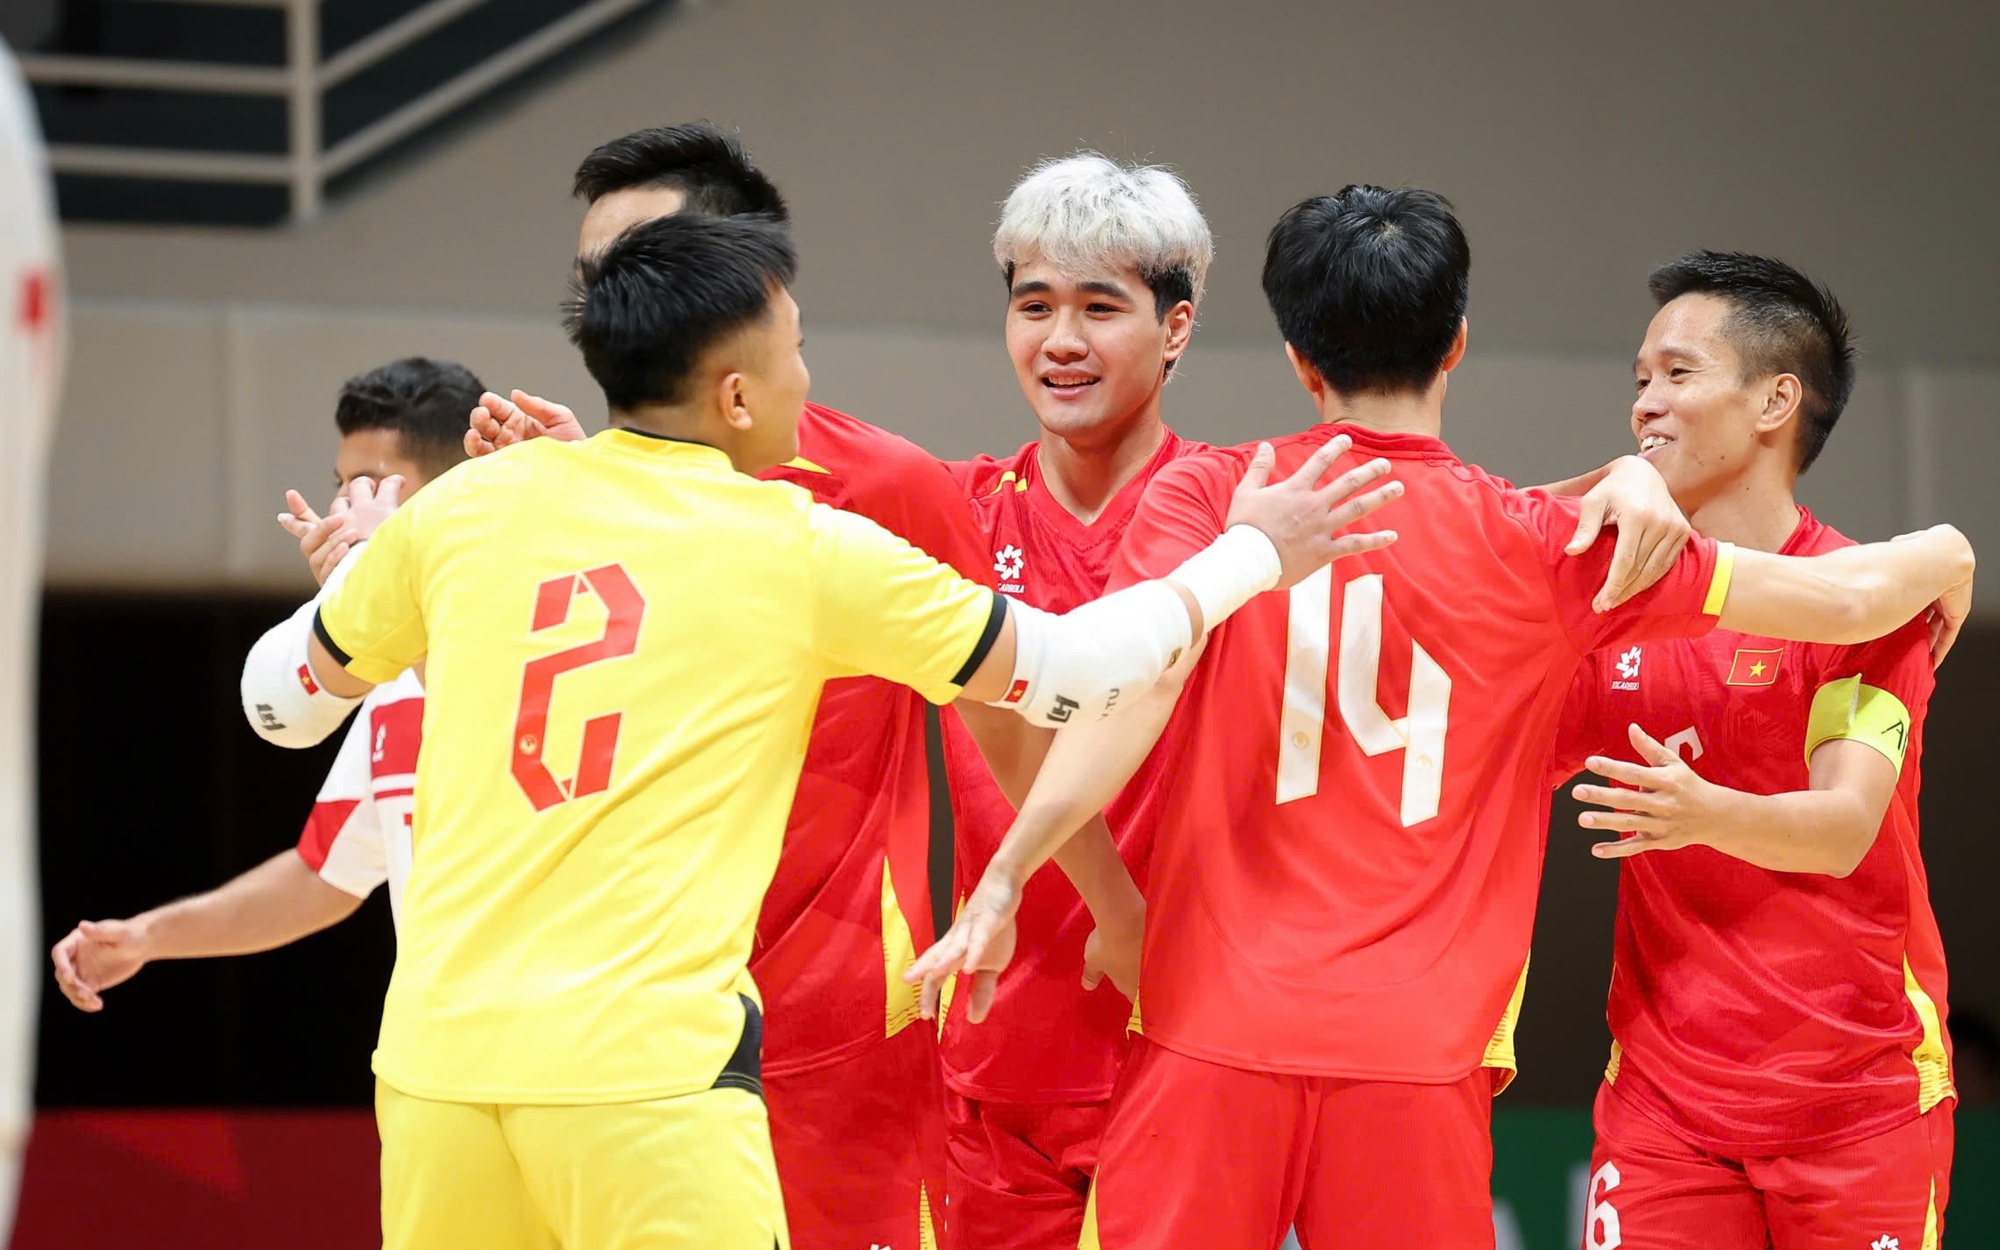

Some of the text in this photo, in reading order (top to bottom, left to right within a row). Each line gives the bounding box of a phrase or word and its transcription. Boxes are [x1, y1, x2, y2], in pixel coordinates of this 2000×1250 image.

[509, 562, 646, 813] 2
[1276, 561, 1452, 828] 14
[1585, 1160, 1622, 1250] 6
